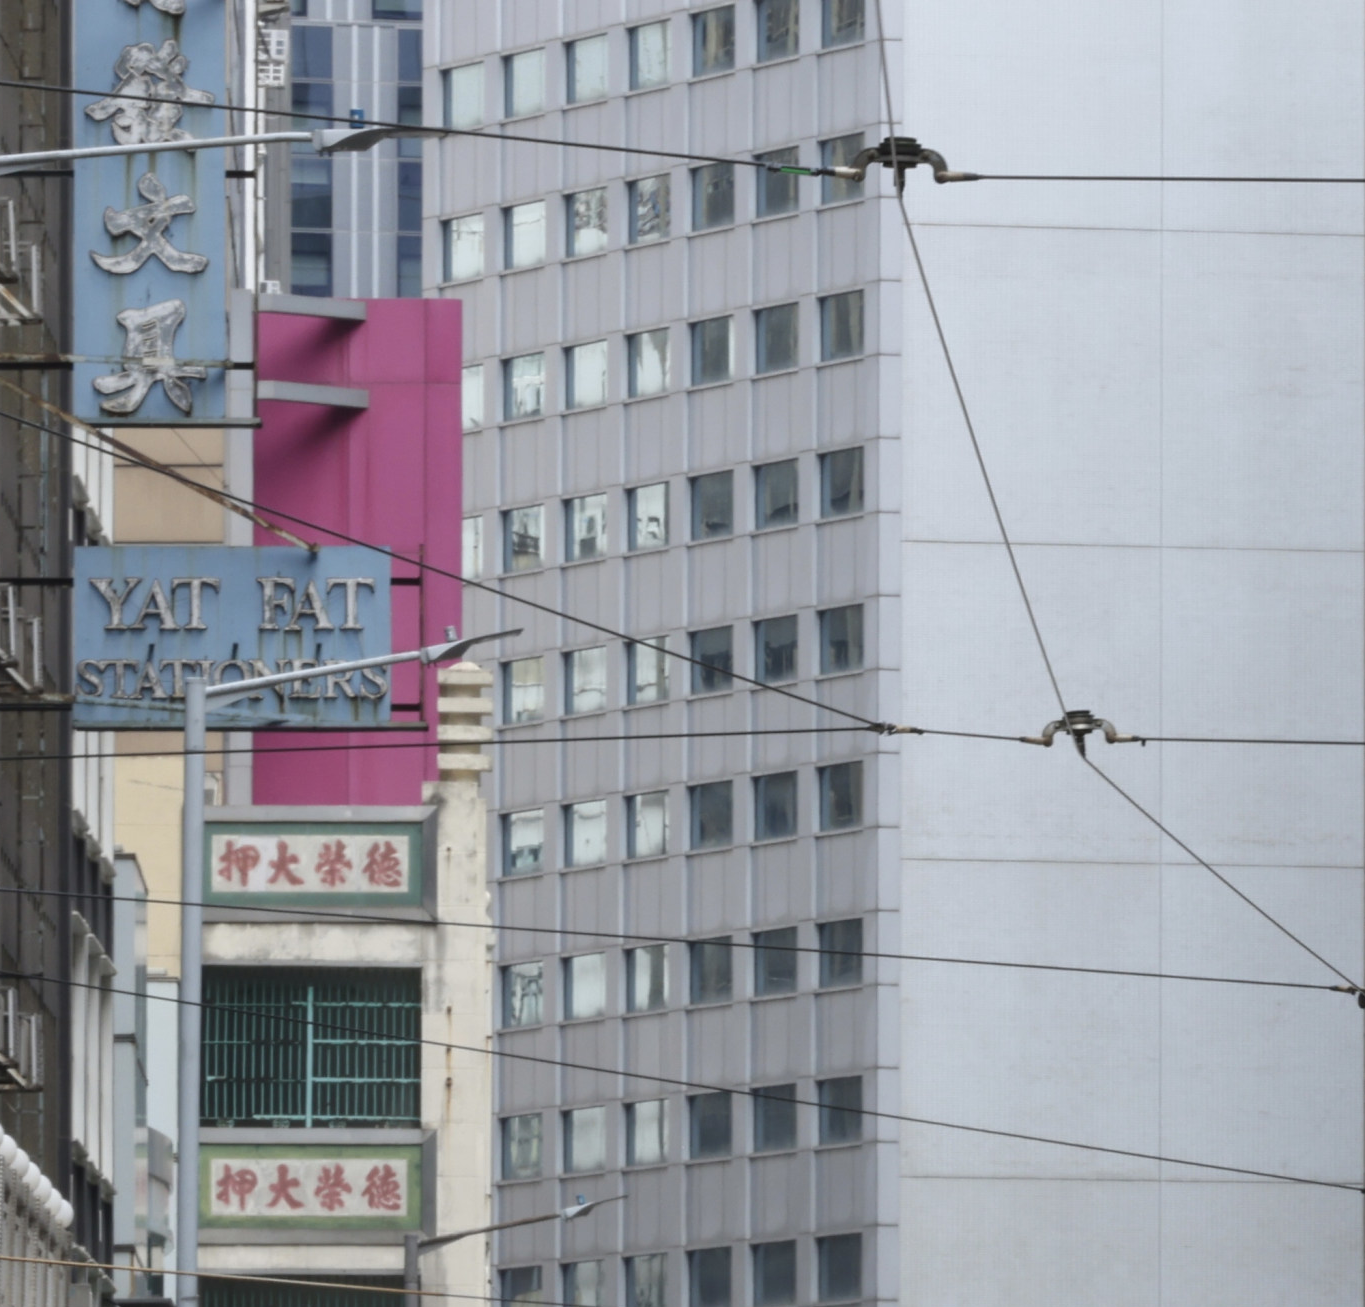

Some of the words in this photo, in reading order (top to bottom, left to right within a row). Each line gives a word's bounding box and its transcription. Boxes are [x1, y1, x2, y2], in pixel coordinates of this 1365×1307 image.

[89, 577, 221, 631] YAT
[256, 577, 376, 631] FAT
[75, 658, 389, 701] STATIONERS
